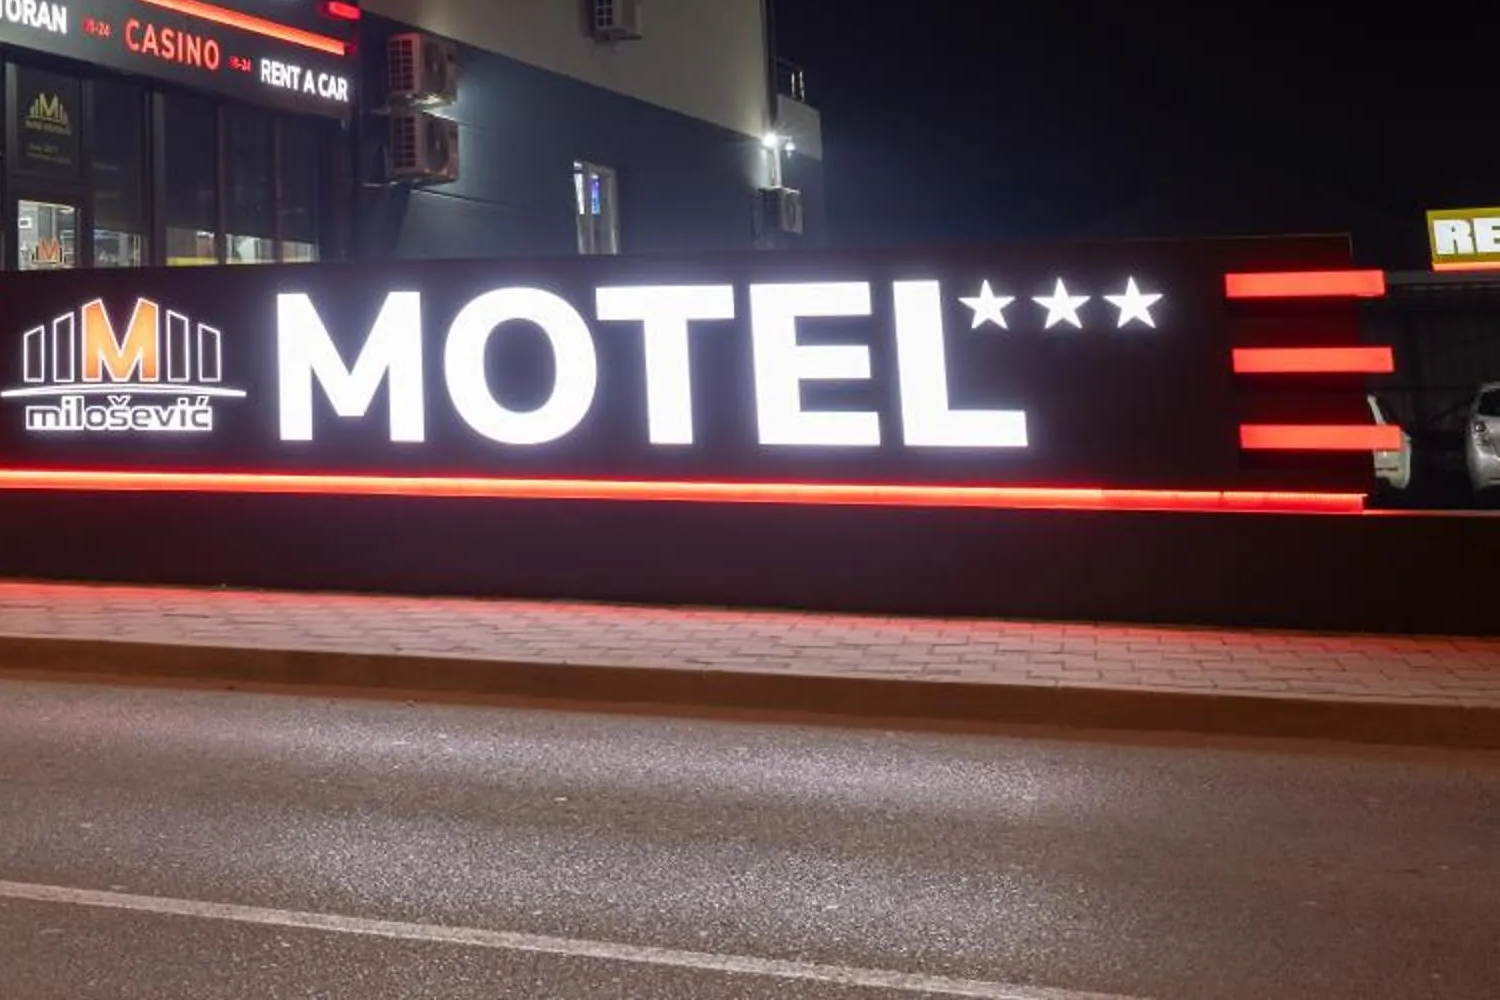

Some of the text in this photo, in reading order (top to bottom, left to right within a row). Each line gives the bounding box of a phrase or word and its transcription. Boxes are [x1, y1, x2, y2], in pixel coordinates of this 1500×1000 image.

[125, 17, 220, 71] CASINO
[259, 58, 303, 90] RENT
[303, 68, 316, 95] A
[318, 72, 349, 103] CAR
[275, 278, 1029, 448] MOTEL
[25, 394, 213, 431] milošević
